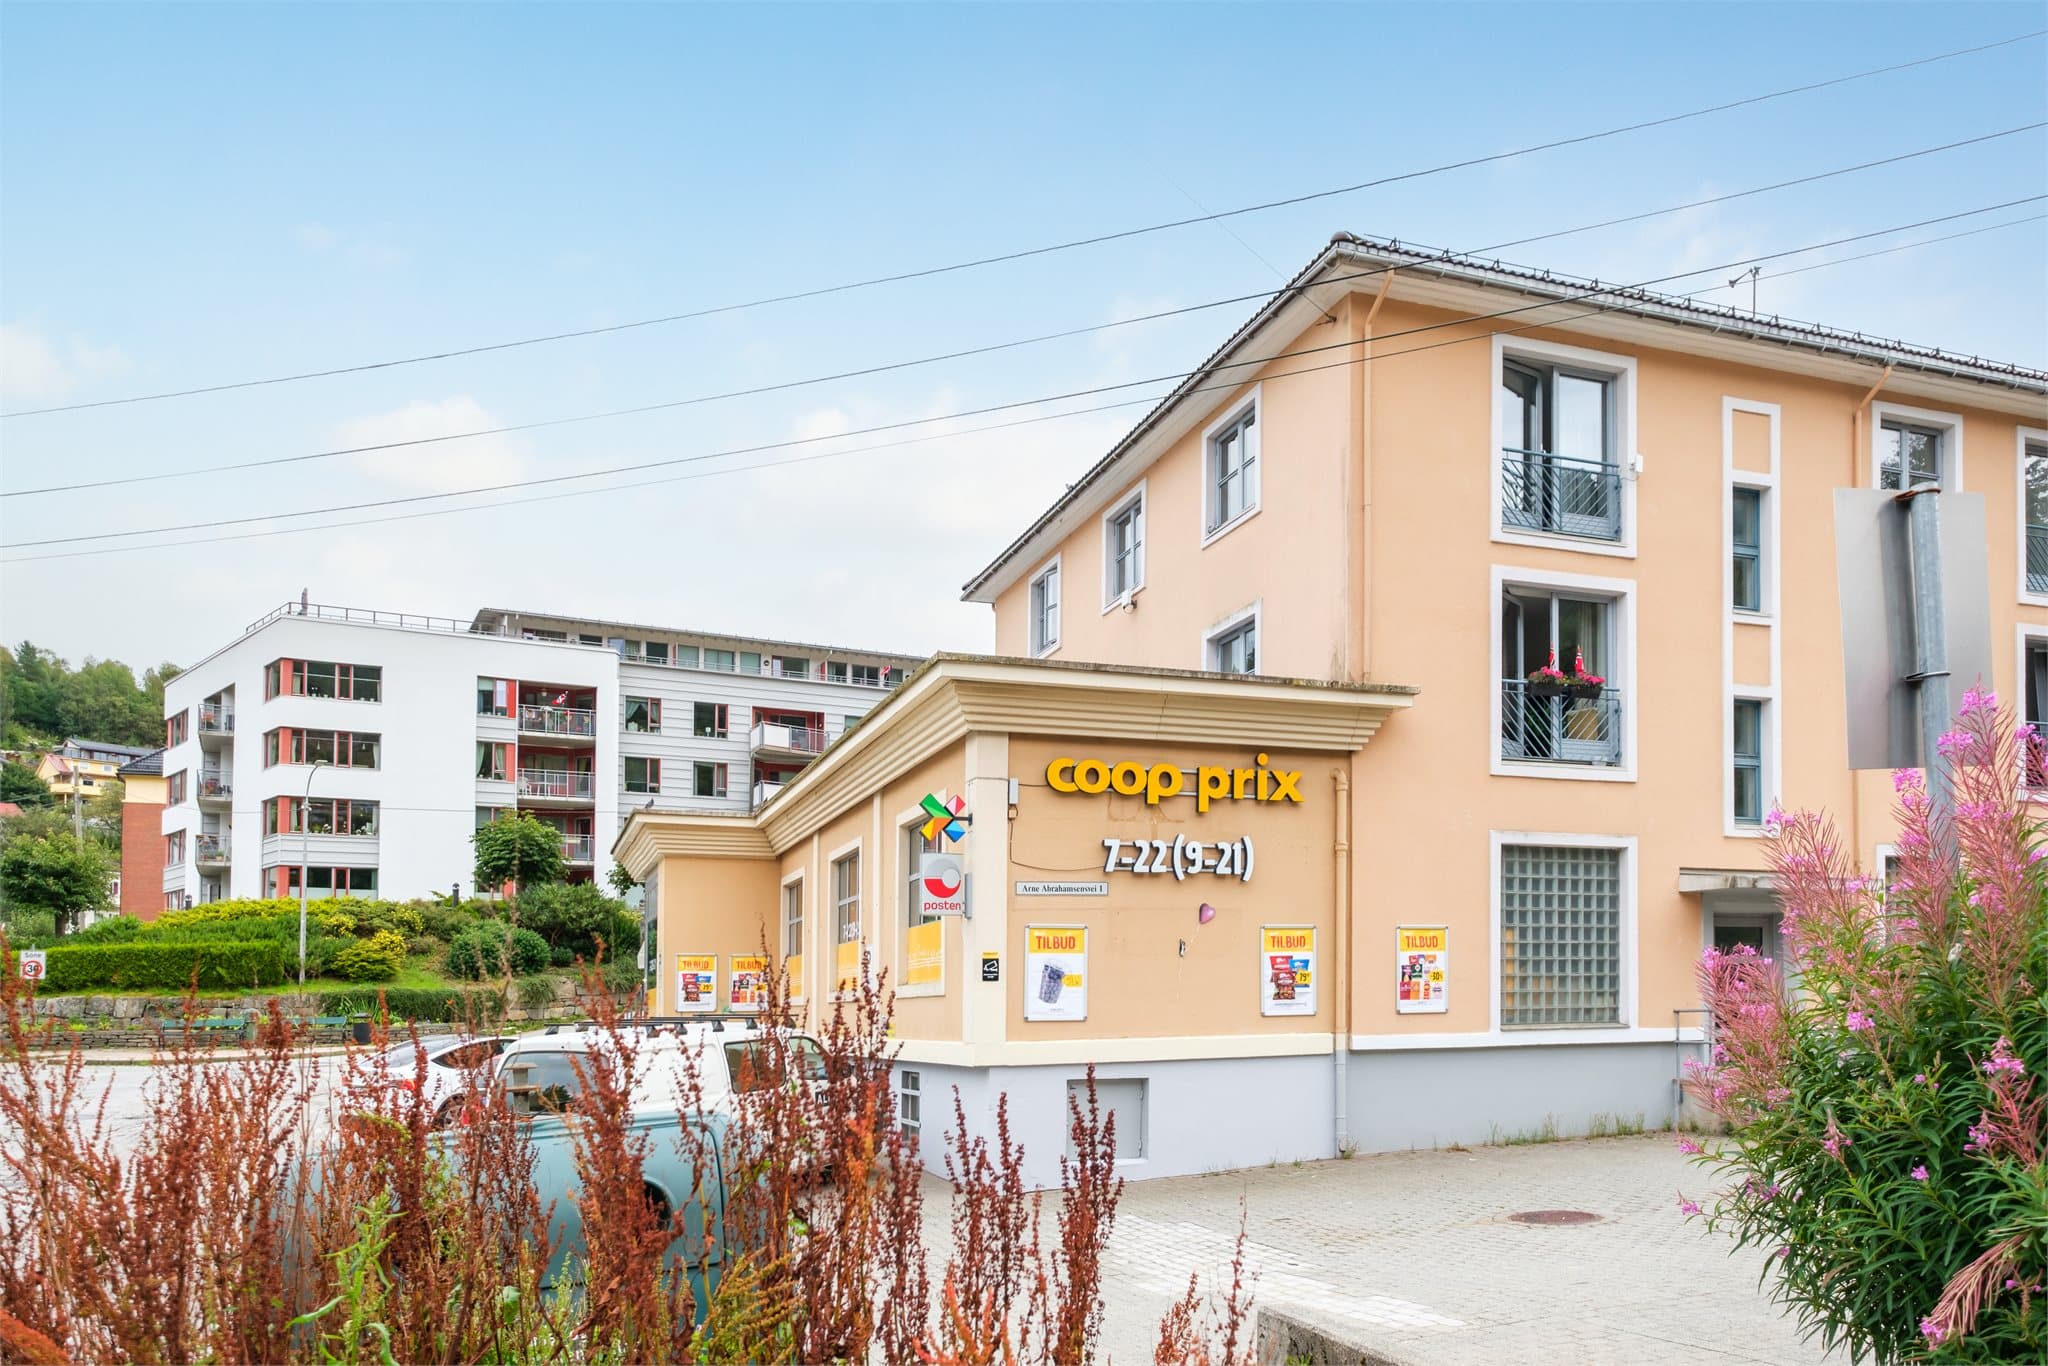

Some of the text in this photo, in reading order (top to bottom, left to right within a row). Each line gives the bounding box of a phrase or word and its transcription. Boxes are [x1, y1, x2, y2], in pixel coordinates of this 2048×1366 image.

[1046, 752, 1305, 813] coop prix
[1023, 884, 1040, 893] Arne
[923, 901, 962, 912] posten
[1035, 935, 1076, 950] TILBUD
[1270, 935, 1306, 948] TILBUD
[1405, 935, 1438, 948] TILBUD
